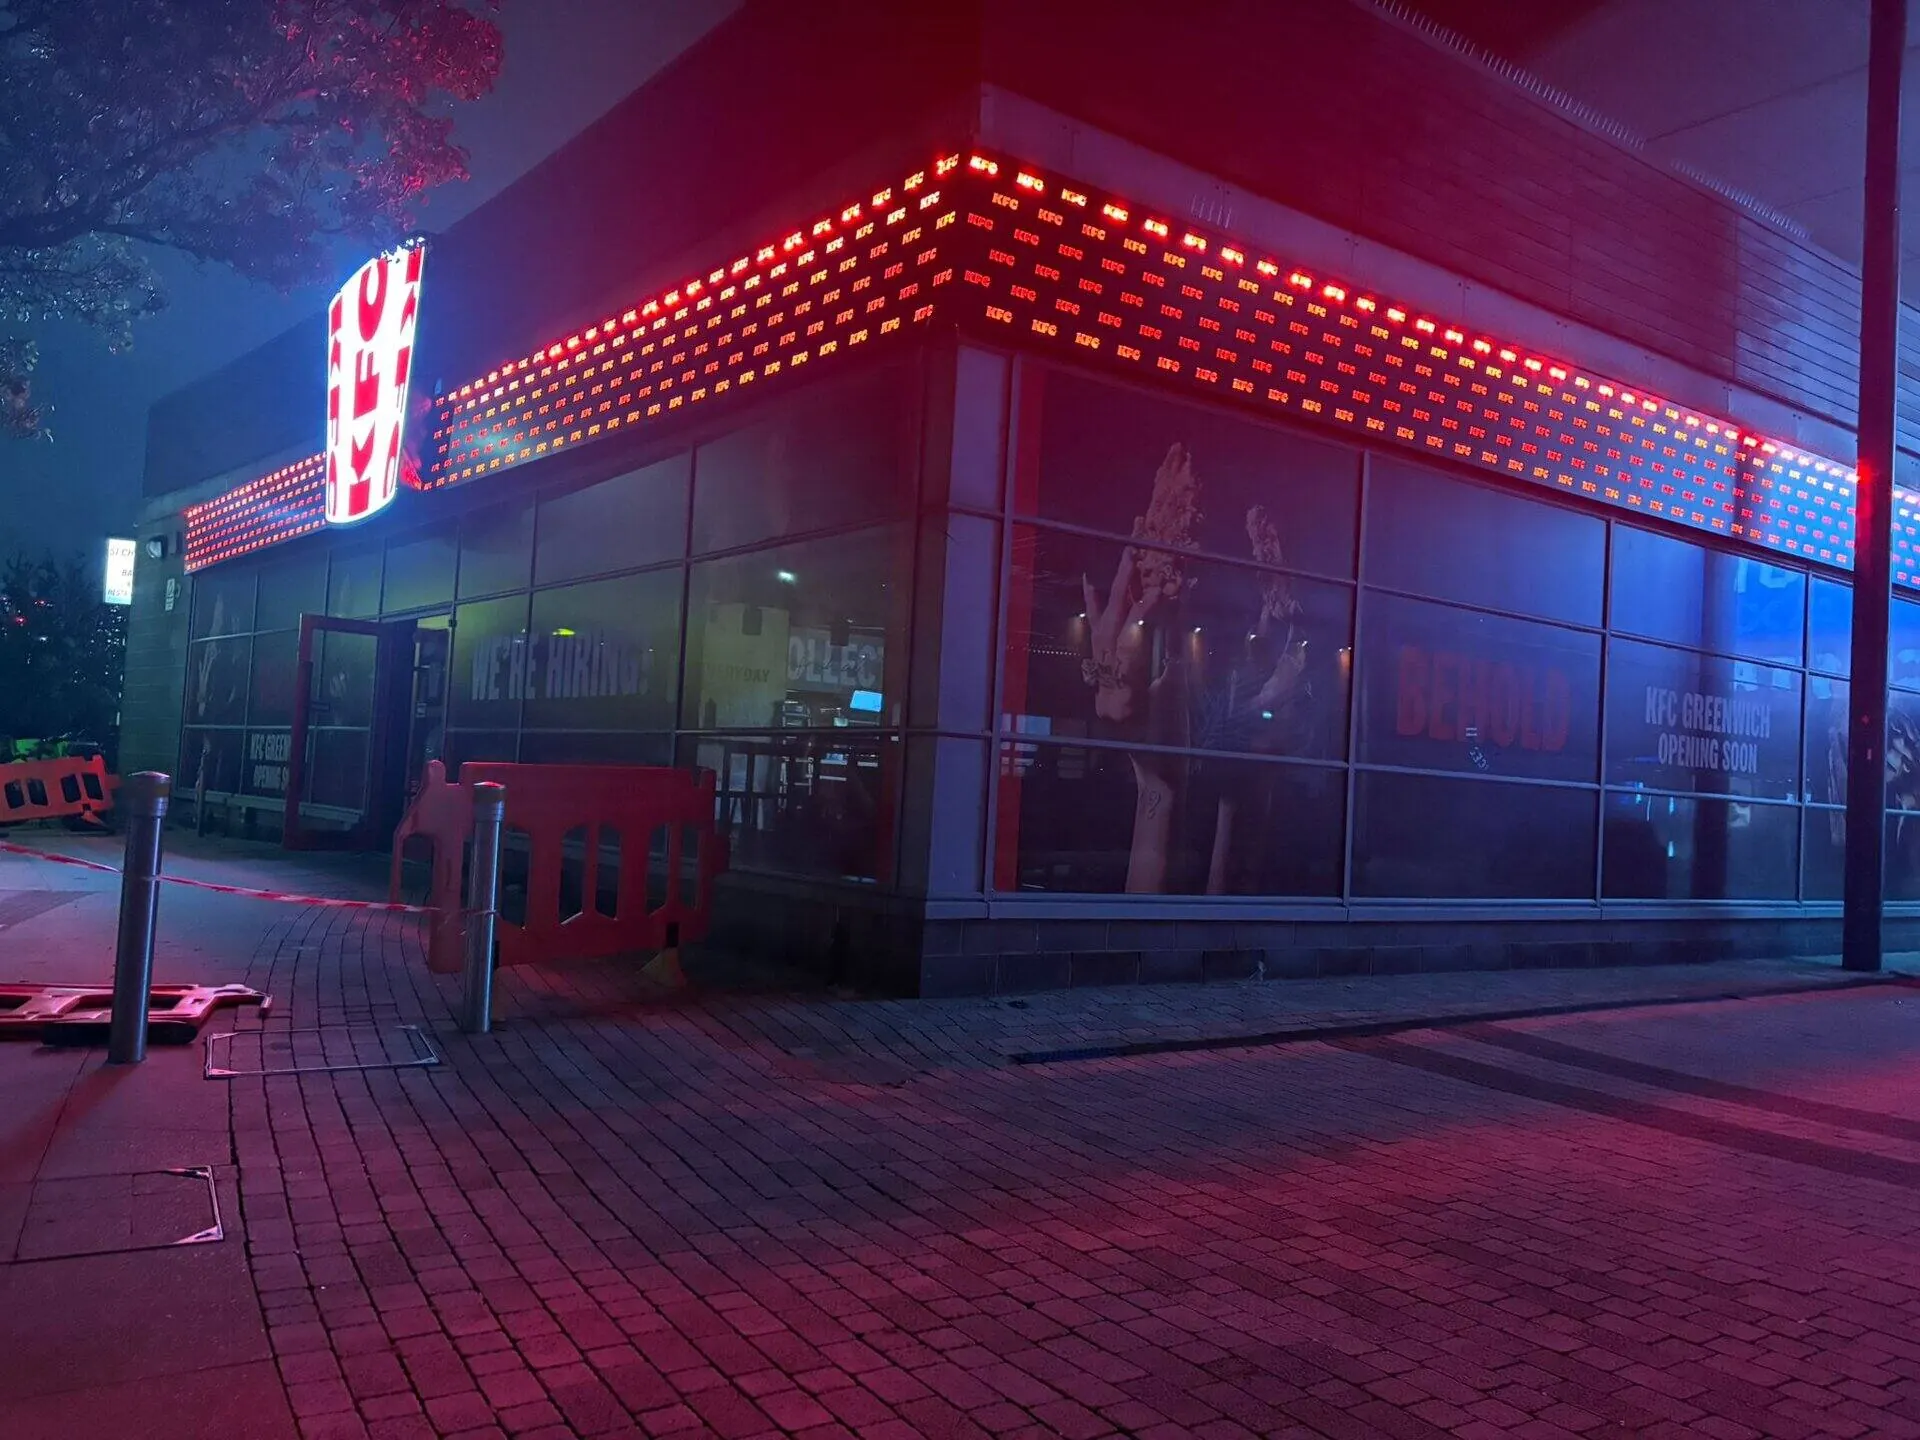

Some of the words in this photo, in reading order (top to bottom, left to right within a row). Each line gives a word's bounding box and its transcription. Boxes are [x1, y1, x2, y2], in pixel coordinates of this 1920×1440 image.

[968, 213, 993, 230] KFC
[1014, 229, 1039, 245] KFC
[1059, 244, 1083, 260] KFC
[992, 193, 1018, 210] KFC
[1038, 209, 1063, 225] KFC
[1082, 224, 1105, 240] KFC
[989, 250, 1015, 266] KFC
[1035, 264, 1059, 280] KFC
[964, 270, 990, 287] KFC
[1011, 285, 1036, 301] KFC
[1056, 299, 1080, 315] KFC
[986, 306, 1012, 323] KFC
[1032, 320, 1057, 336] KFC
[1075, 333, 1100, 348] KFC
[347, 257, 389, 516] KFC
[1396, 643, 1570, 752] BEHOLD
[1645, 685, 1678, 727] KFC
[1681, 691, 1771, 739] GREENWICH
[1658, 732, 1719, 770] OPENING
[1722, 740, 1758, 774] SOON
